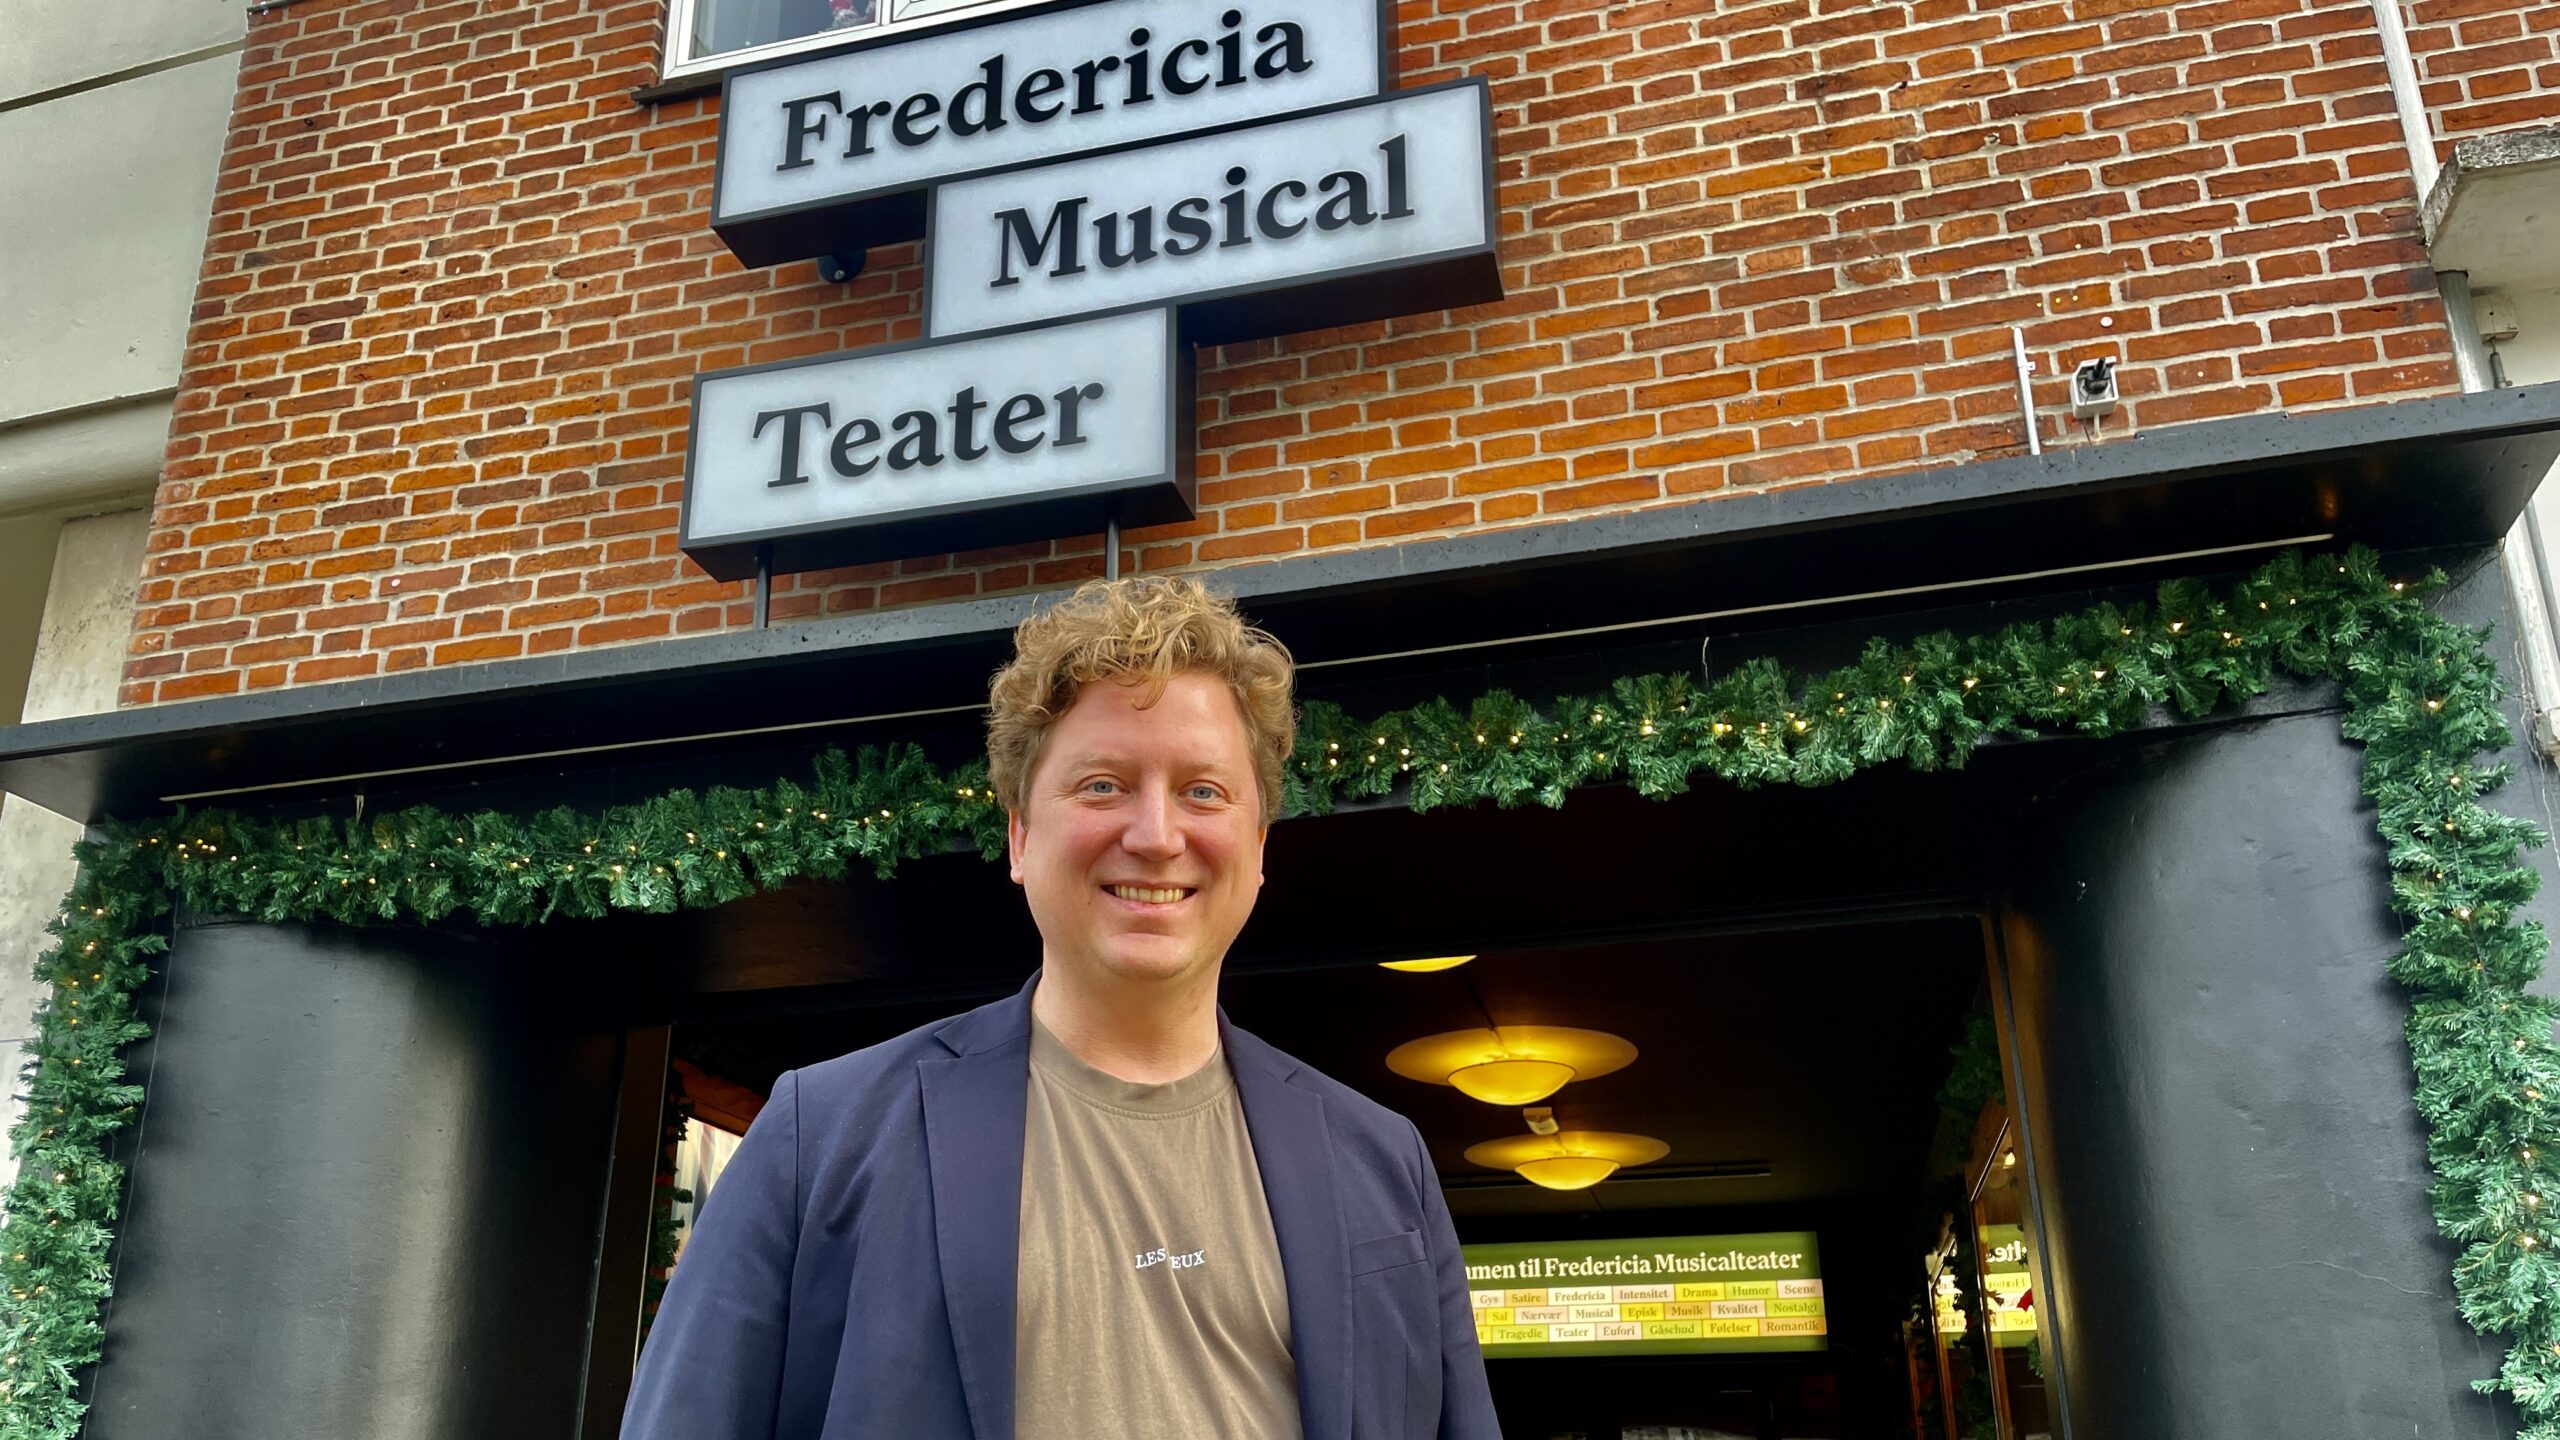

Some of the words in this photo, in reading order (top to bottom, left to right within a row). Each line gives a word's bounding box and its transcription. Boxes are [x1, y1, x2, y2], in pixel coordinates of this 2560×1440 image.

[776, 9, 1312, 172] Fredericia
[990, 134, 1415, 288] Musical
[753, 381, 1104, 488] Teater
[1135, 1248, 1166, 1269] LES
[1168, 1249, 1205, 1269] EUX
[1519, 1257, 1541, 1278] til
[1544, 1254, 1652, 1278] Fredericia
[1654, 1250, 1801, 1273] Musicalteater
[1512, 1293, 1541, 1303] Satire
[1555, 1290, 1605, 1301] Fredericia
[1620, 1287, 1668, 1300] Intensitet
[1682, 1287, 1718, 1298] Drama
[1732, 1285, 1770, 1296] Humor
[1784, 1284, 1816, 1294] Scene
[1492, 1311, 1508, 1321] Sal
[1521, 1311, 1561, 1321] Nærvær
[1575, 1308, 1614, 1319] Musical
[1628, 1306, 1657, 1319] Episk
[1671, 1305, 1703, 1316] Musik
[1718, 1303, 1758, 1315] Kvalitet
[1774, 1301, 1818, 1314] Nostalgi
[1499, 1328, 1542, 1341] Tragedie
[1556, 1327, 1589, 1338] Teater
[1603, 1325, 1635, 1336] Eufori
[1650, 1323, 1695, 1335] Gåsehud
[1710, 1322, 1752, 1333] Følelser
[1766, 1320, 1819, 1332] Romantik
